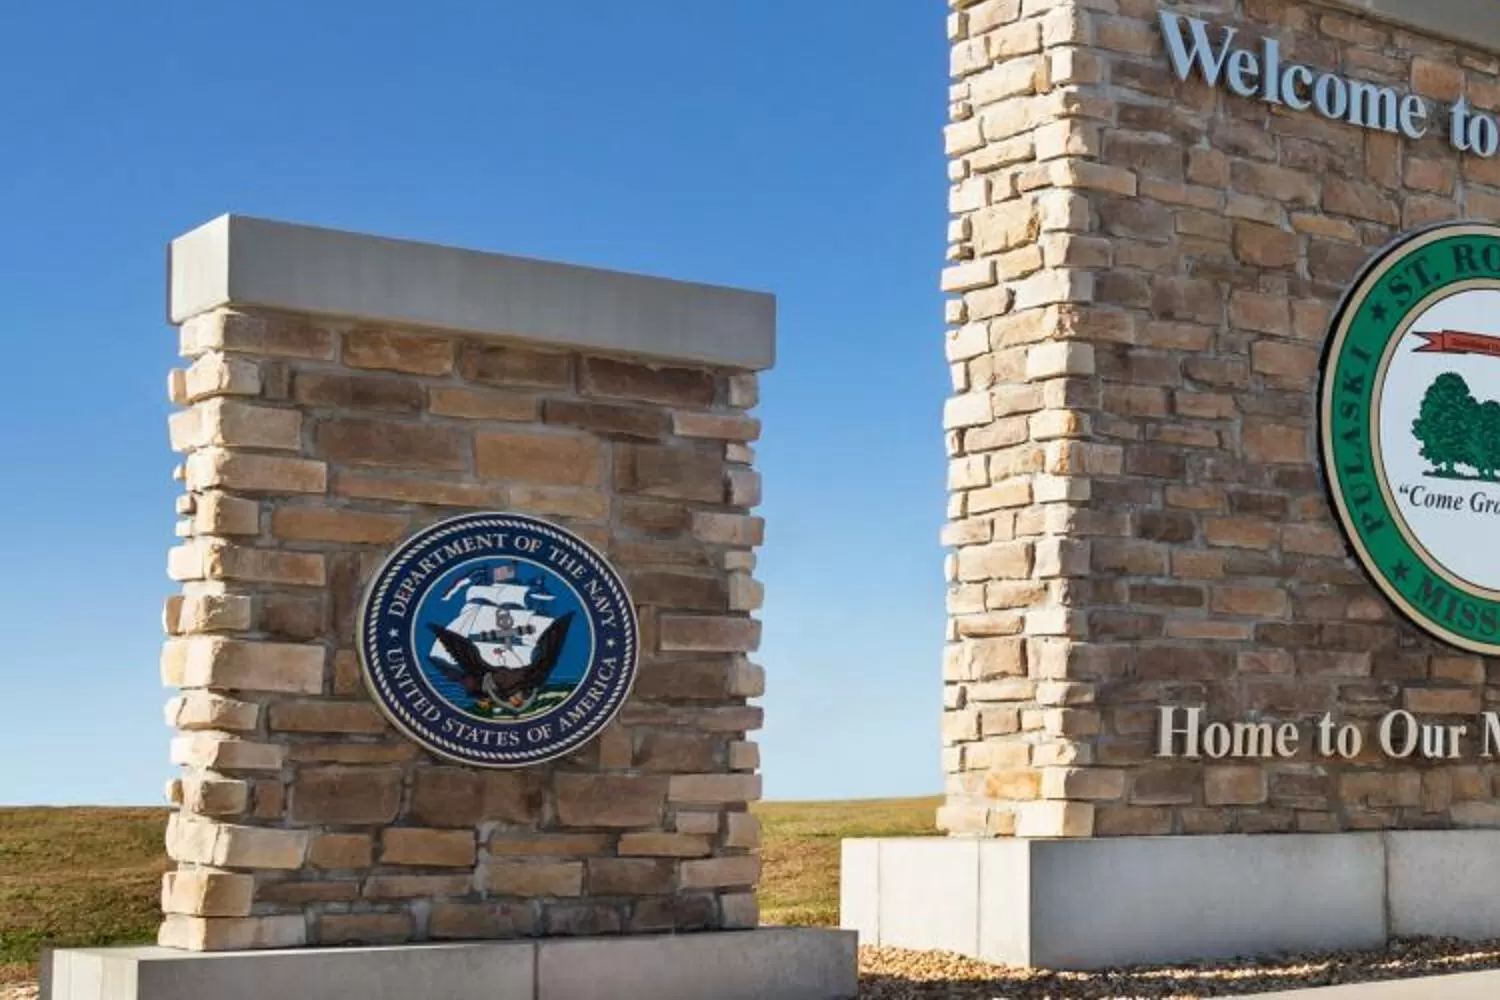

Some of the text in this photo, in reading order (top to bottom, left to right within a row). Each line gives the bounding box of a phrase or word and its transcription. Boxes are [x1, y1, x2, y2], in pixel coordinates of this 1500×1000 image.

[1159, 9, 1429, 138] Welcome
[1448, 93, 1500, 157] to
[1388, 256, 1441, 303] ST.
[1339, 345, 1386, 535] PULASKI
[388, 532, 617, 629] DEPARTMENT OF THE NAVY
[387, 647, 618, 748] UNITED STATES OF AMERICA
[1156, 706, 1300, 759] Home
[1319, 711, 1363, 759] to
[1379, 708, 1468, 759] Our
